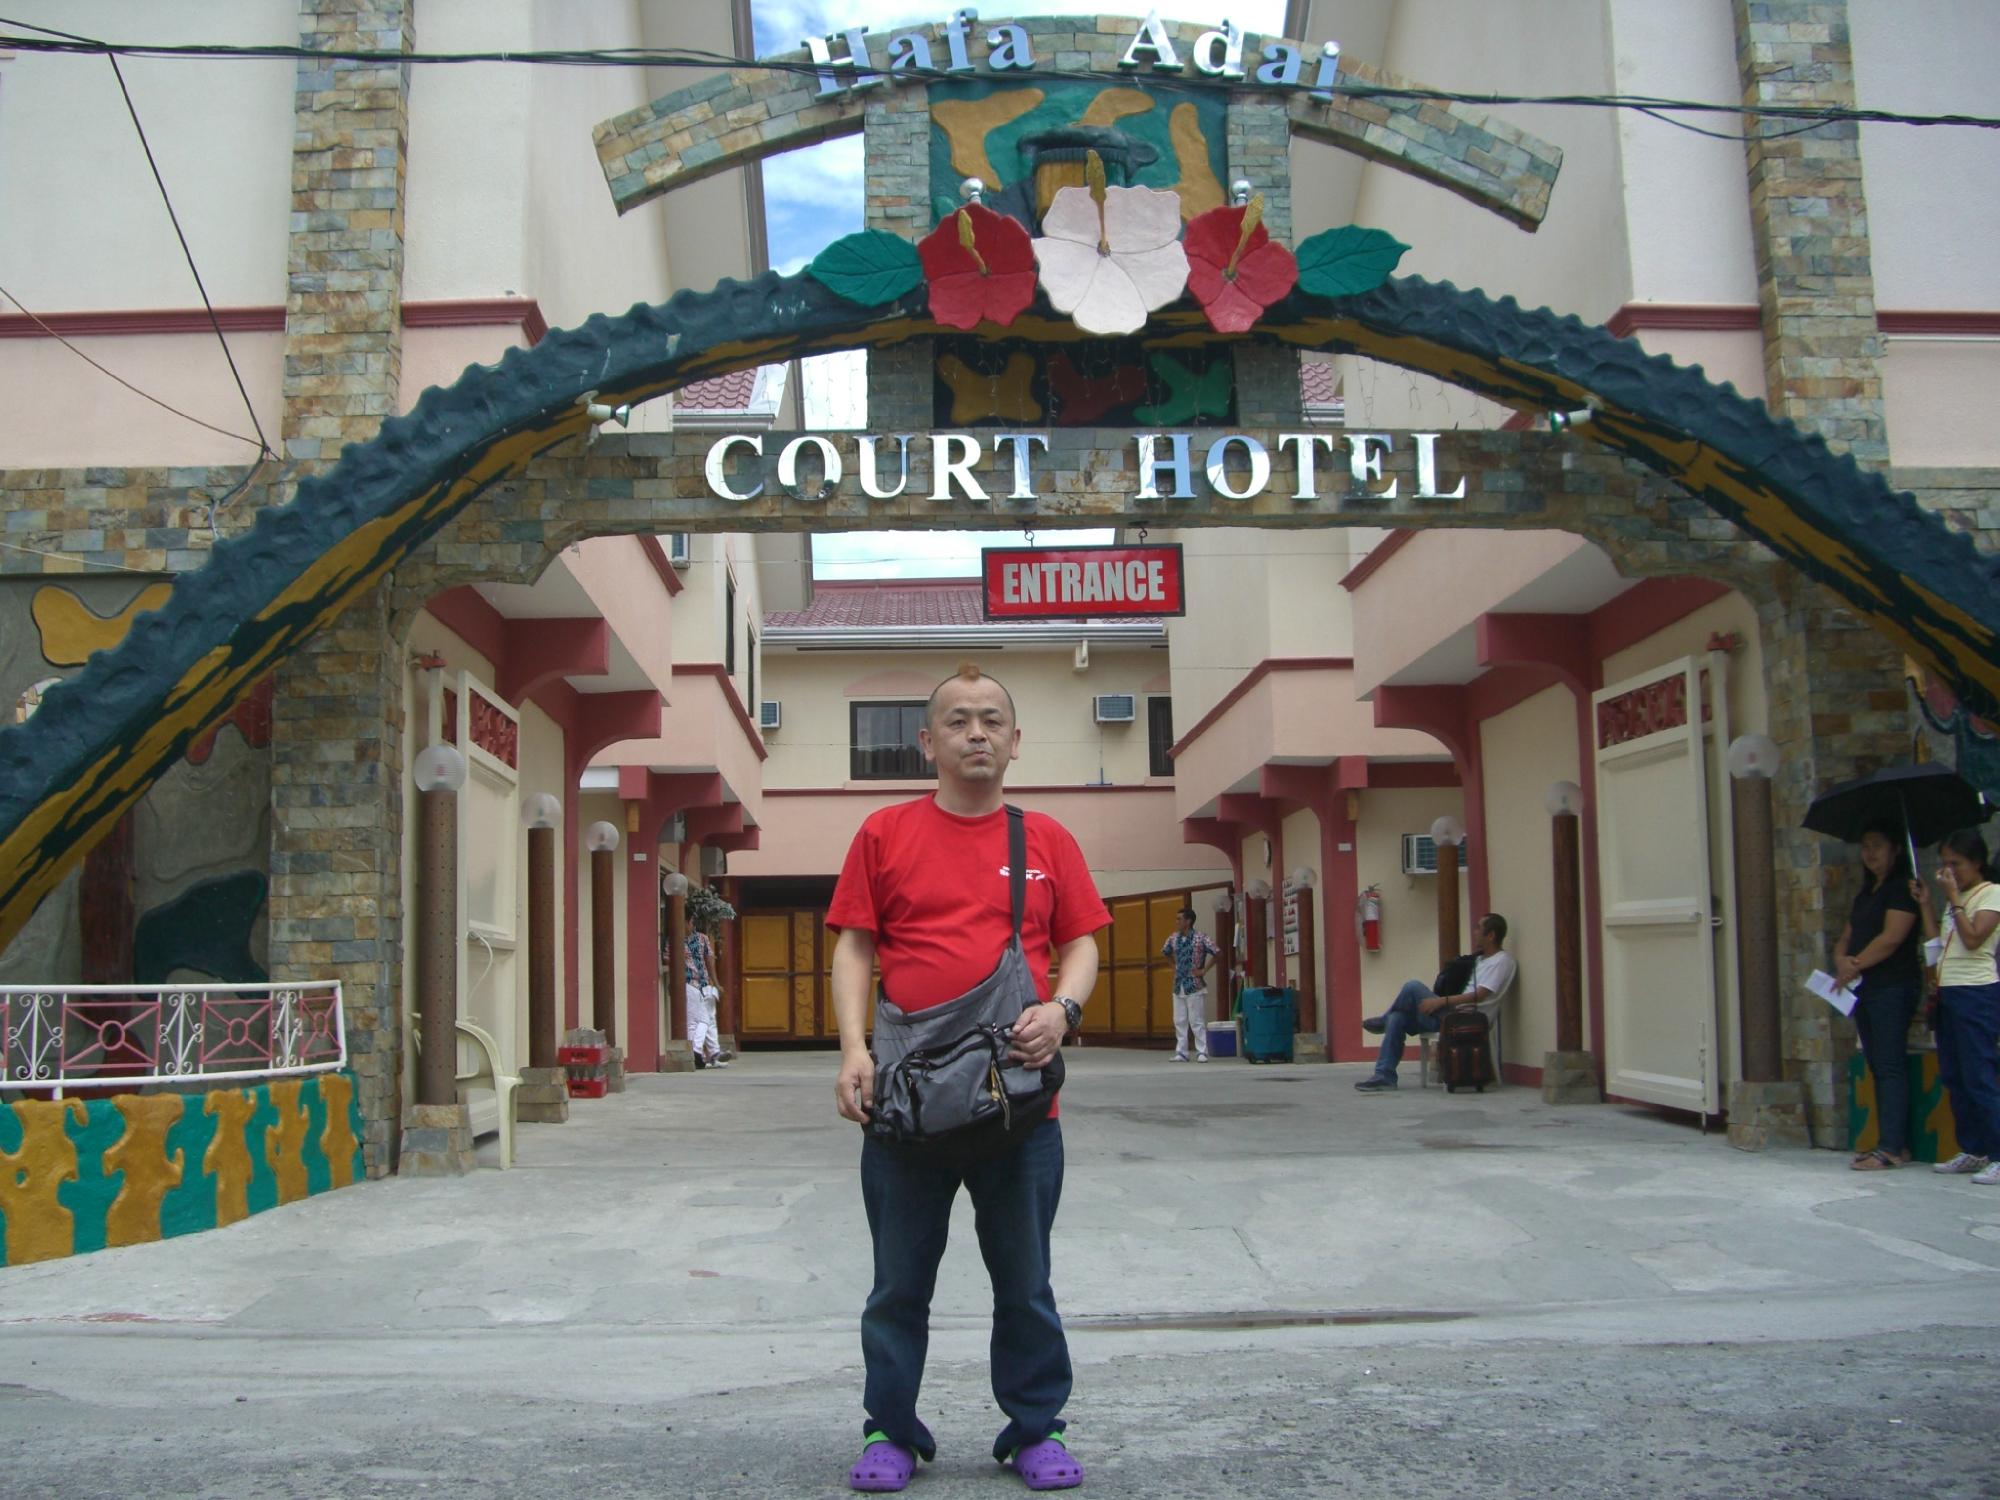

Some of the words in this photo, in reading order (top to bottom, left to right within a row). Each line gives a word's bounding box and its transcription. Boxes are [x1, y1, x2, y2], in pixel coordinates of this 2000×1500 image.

[802, 8, 1037, 100] Hafa
[1118, 9, 1341, 104] Adai
[704, 433, 1050, 501] COURT
[1133, 433, 1468, 501] HOTEL
[1002, 560, 1165, 604] ENTRANCE
